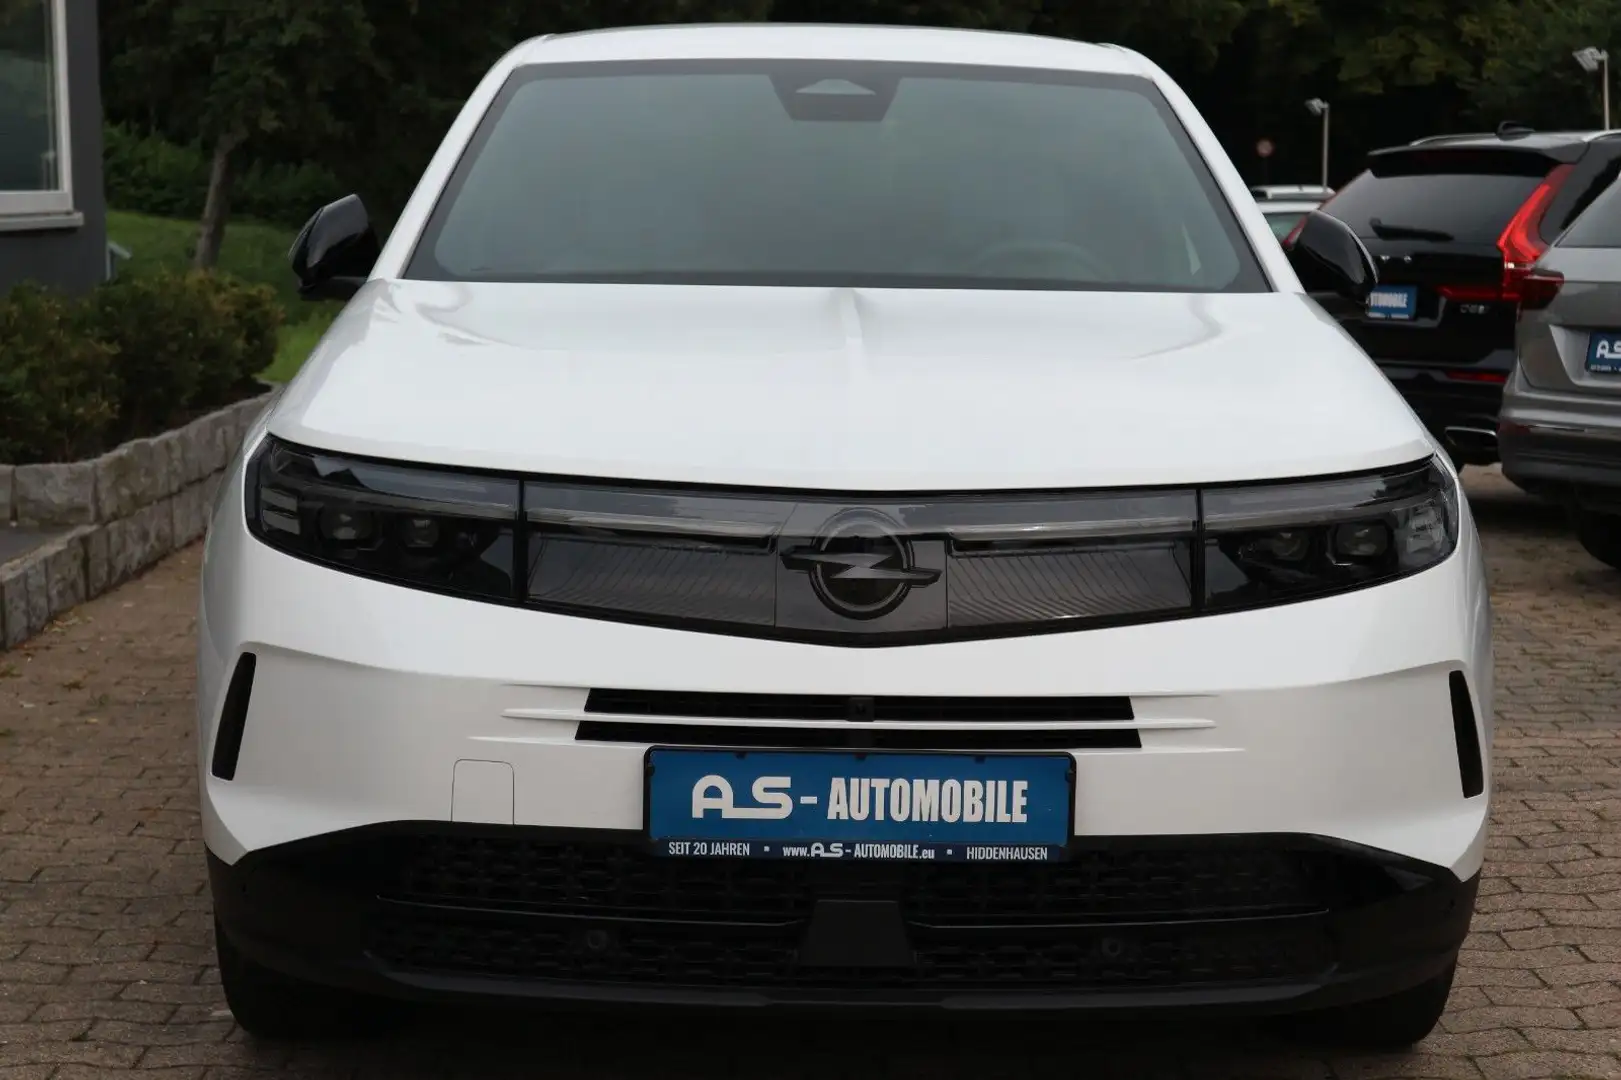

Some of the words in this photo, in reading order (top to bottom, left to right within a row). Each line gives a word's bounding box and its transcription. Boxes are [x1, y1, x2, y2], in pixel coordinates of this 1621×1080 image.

[827, 777, 1029, 824] AUTOMOBILE
[668, 841, 691, 856] SEIT
[693, 842, 707, 856] 20
[709, 842, 750, 856] JAHREN
[966, 847, 1048, 861] HIDDENHAUSEN
